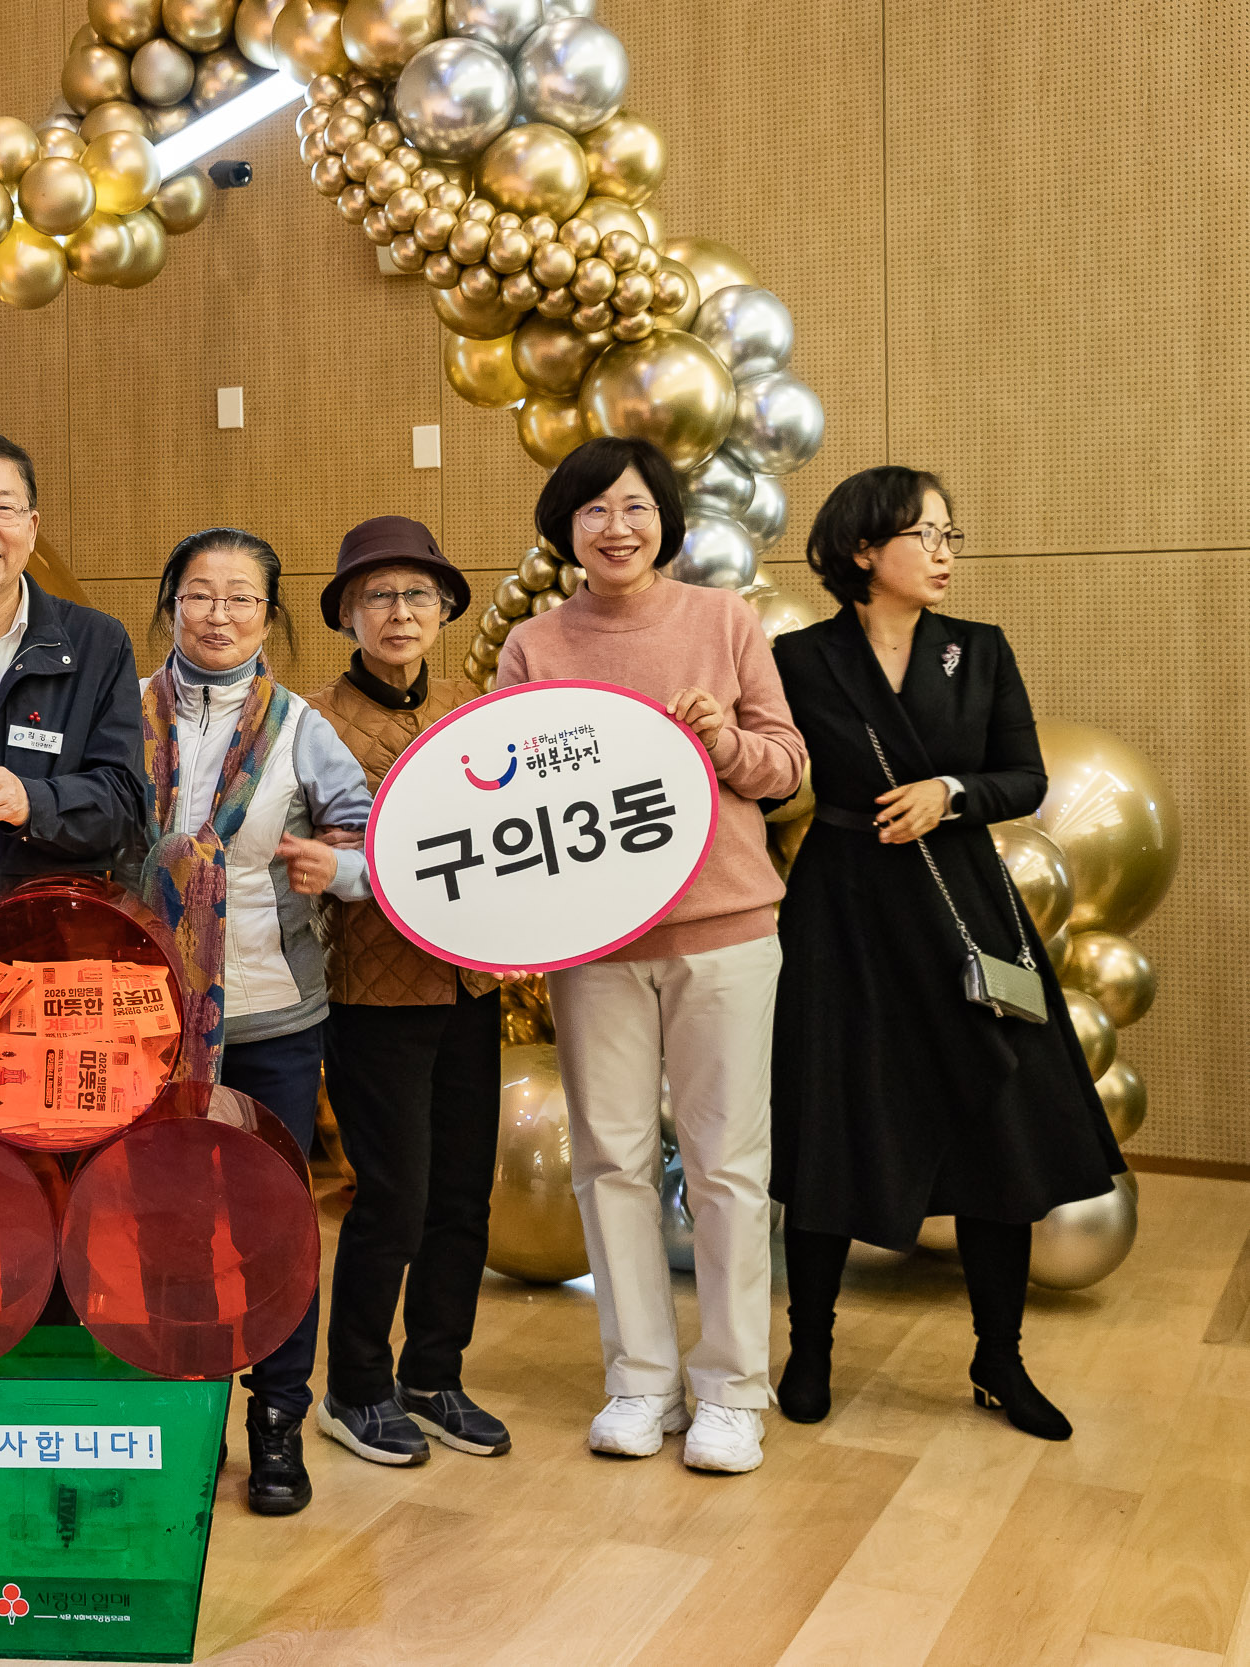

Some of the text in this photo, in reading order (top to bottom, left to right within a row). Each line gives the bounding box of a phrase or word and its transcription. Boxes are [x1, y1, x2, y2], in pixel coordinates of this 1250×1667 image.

[523, 724, 595, 753] 소통하며 발전하는
[526, 740, 601, 779] 행복광진
[415, 778, 677, 903] 구의3동
[44, 986, 103, 998] 2026 희망온돌
[43, 998, 104, 1016] 따뜻한
[98, 1052, 108, 1075] 2026
[78, 1050, 97, 1112] 따뜻한
